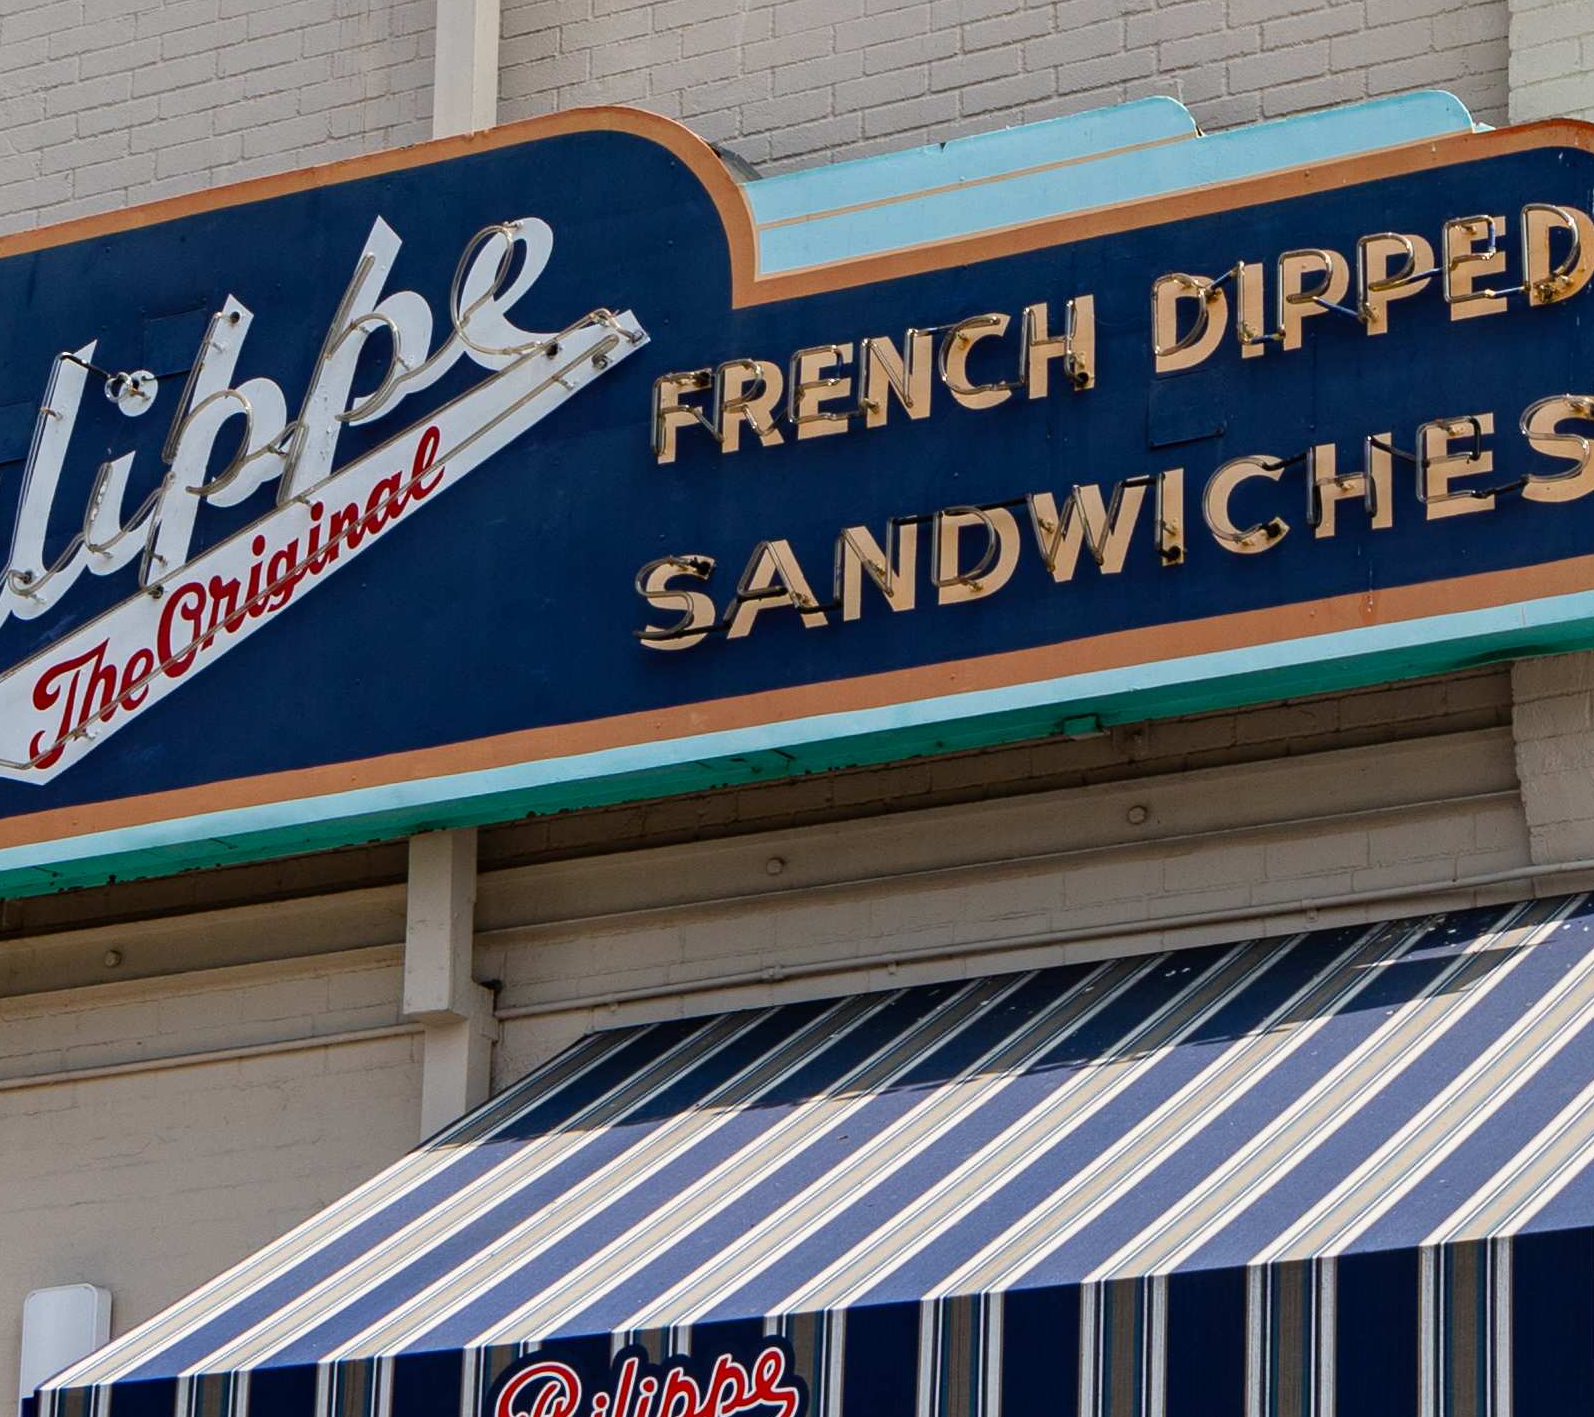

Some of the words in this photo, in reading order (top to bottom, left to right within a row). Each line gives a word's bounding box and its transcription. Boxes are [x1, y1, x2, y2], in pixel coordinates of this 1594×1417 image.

[650, 294, 1096, 464] FRENCH
[29, 638, 154, 770] The
[157, 424, 444, 679] Original
